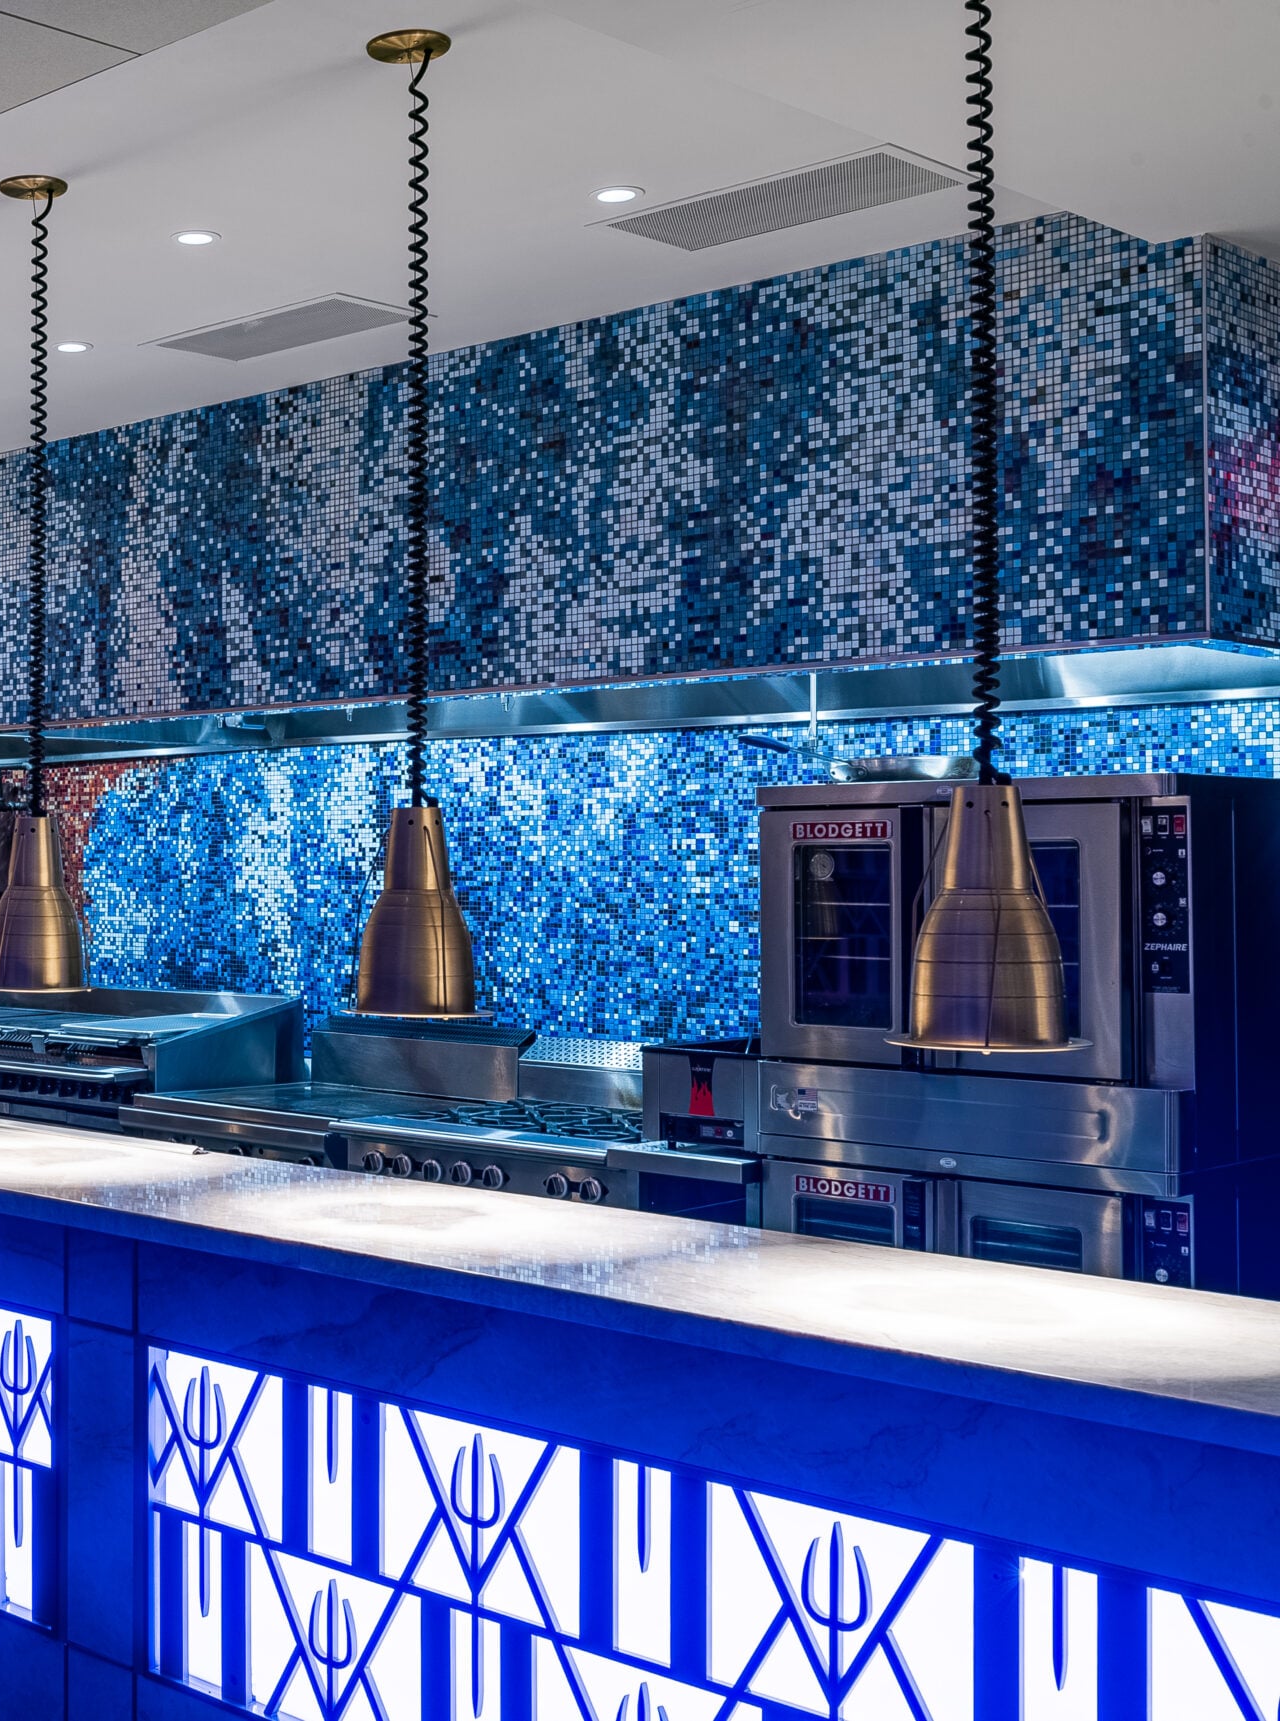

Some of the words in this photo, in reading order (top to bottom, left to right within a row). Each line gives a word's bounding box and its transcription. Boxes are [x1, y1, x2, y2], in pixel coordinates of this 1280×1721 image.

[796, 823, 884, 838] BLODGETT
[1144, 943, 1188, 952] ZEPHAIRE
[799, 1177, 887, 1201] BLODGETT
